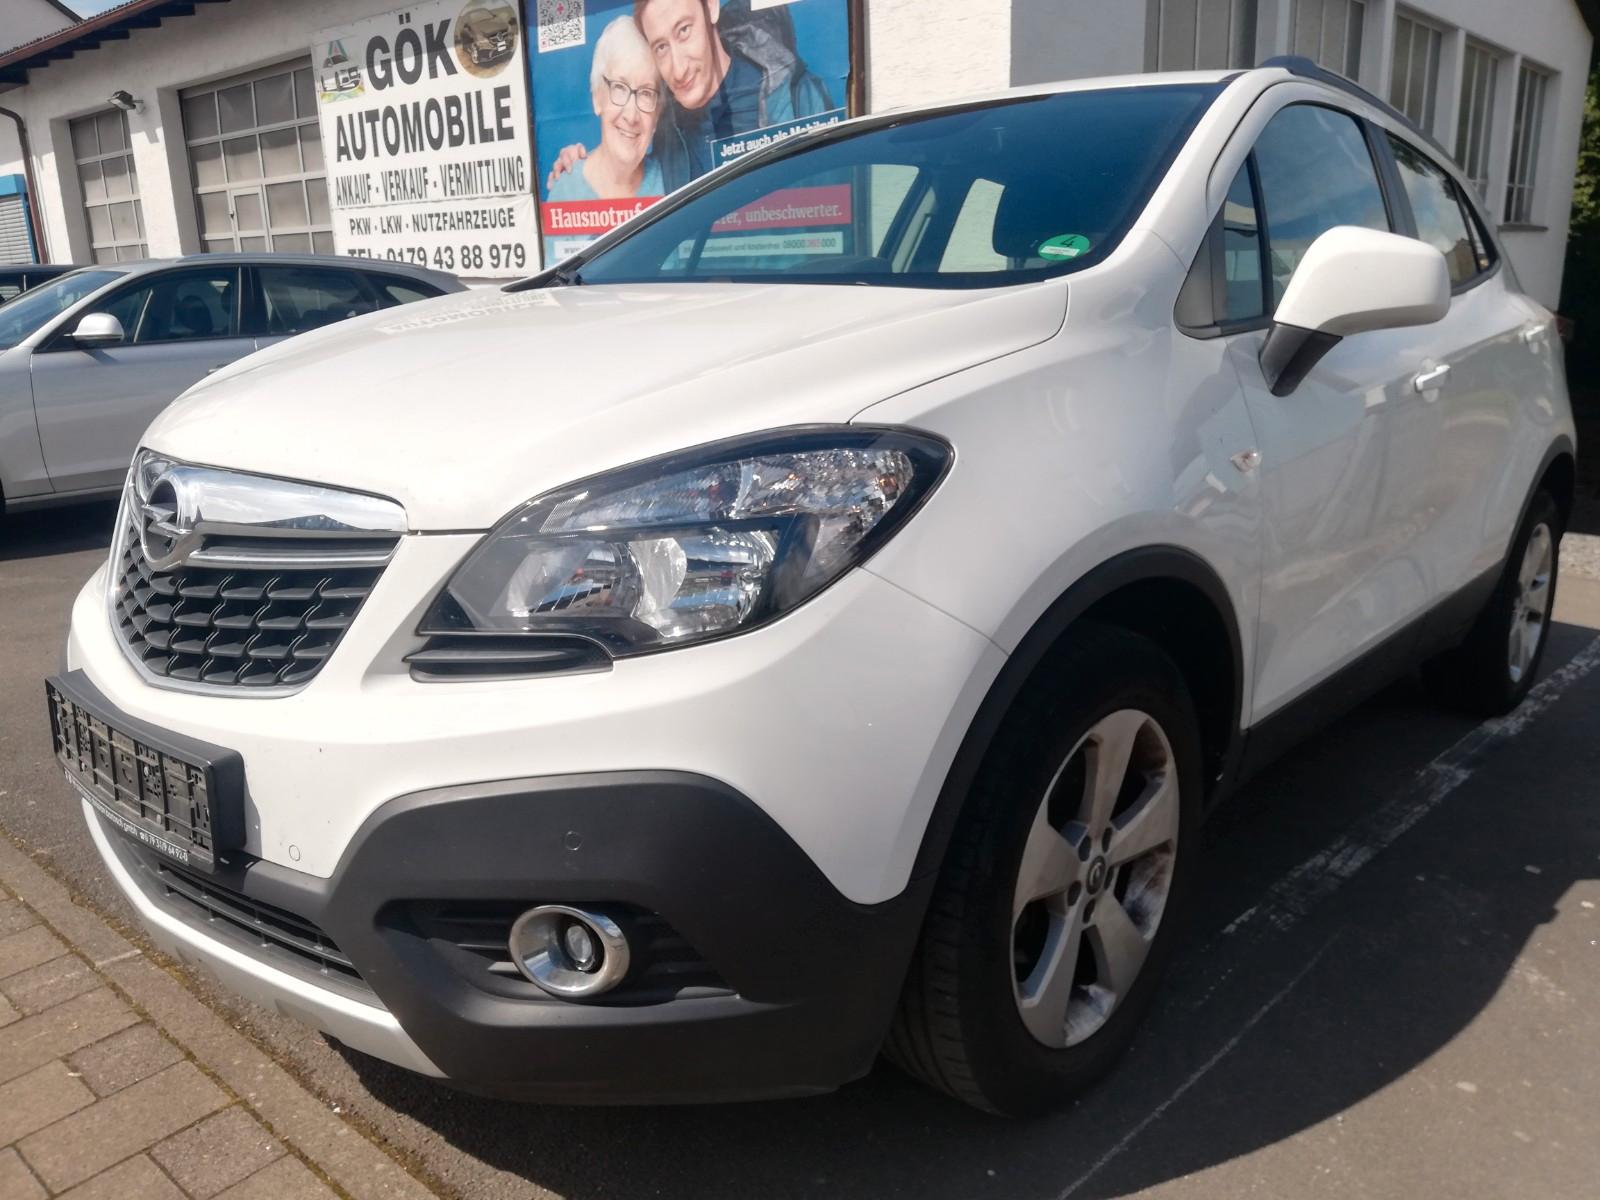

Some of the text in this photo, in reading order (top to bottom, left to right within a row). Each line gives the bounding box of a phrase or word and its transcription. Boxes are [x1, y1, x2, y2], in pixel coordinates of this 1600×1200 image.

[366, 13, 458, 90] GÖK
[336, 85, 515, 163] AUTOMOBILE
[720, 141, 746, 157] Jetzt
[746, 135, 772, 150] auch
[336, 155, 525, 206] ANKAUF VERKAUF VERMITTLUNG
[350, 207, 516, 236] PKW LKW NUTZFAHRZEUGE
[745, 204, 842, 223] unbeschwerter.
[387, 247, 427, 269] 0179
[433, 246, 455, 269] 43
[461, 245, 483, 269] 88
[489, 243, 526, 268] 979
